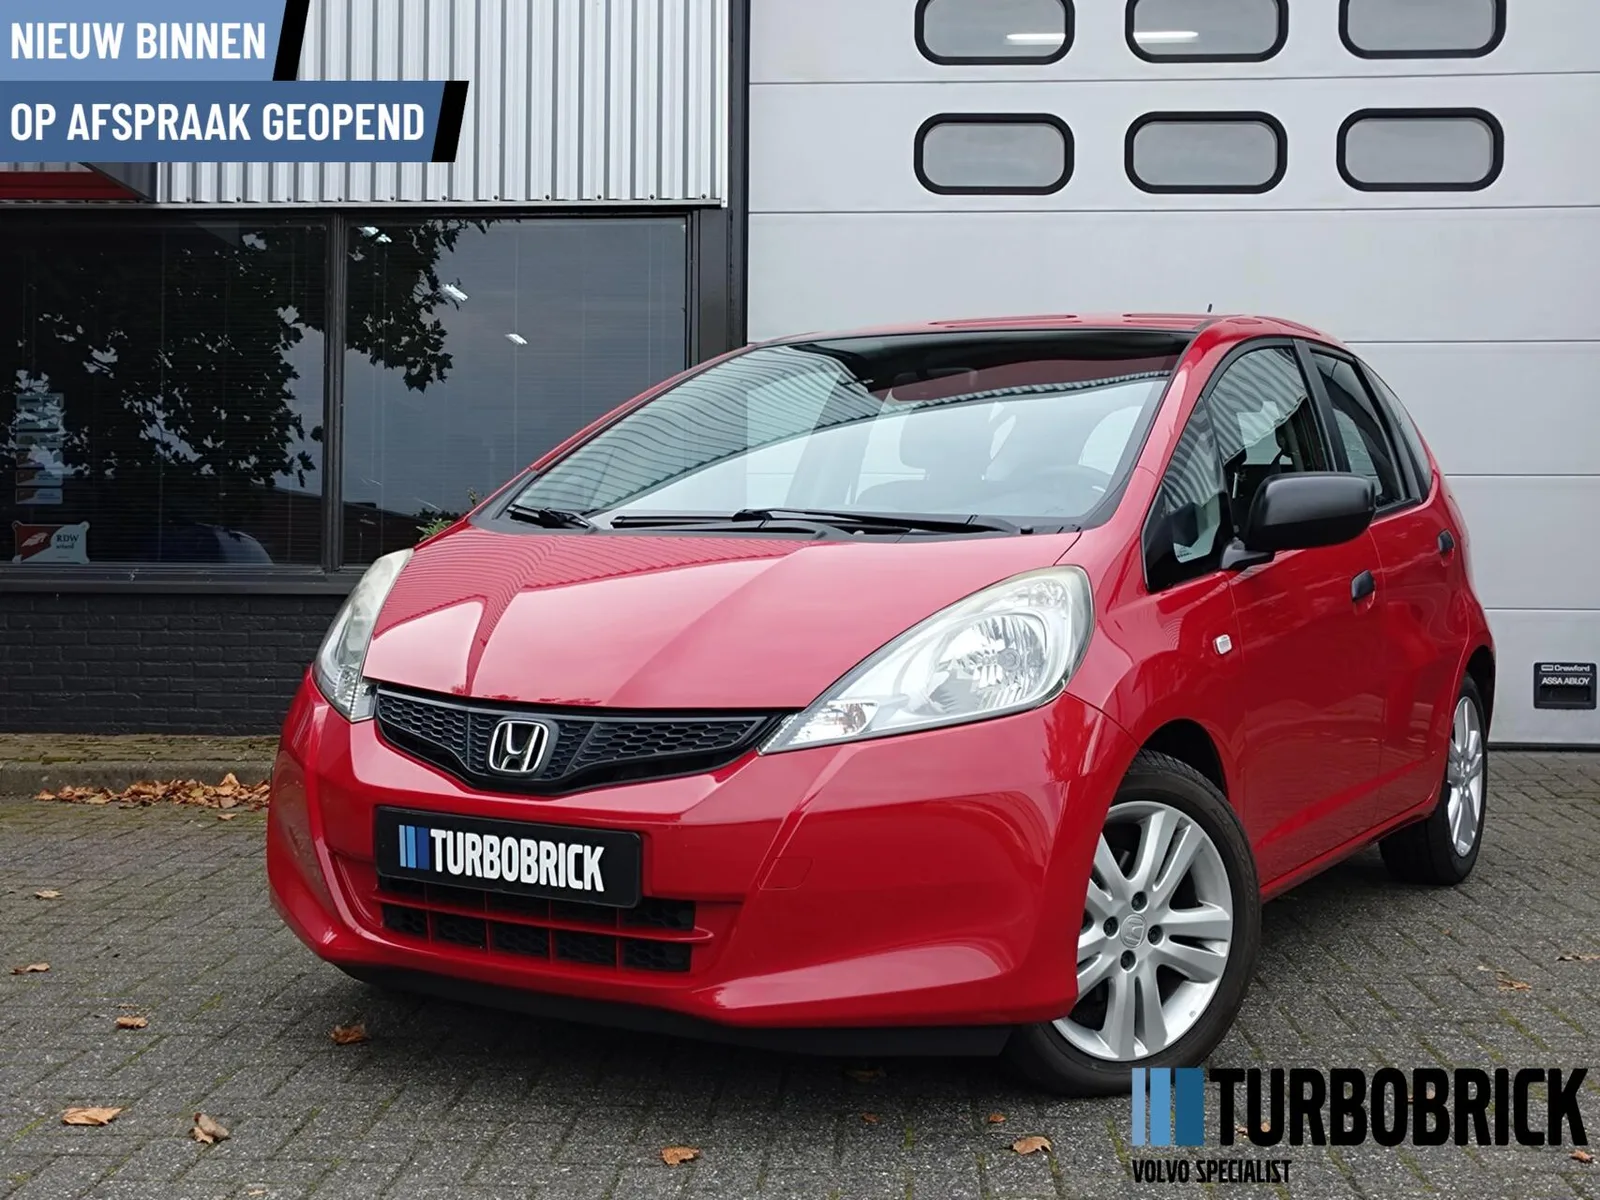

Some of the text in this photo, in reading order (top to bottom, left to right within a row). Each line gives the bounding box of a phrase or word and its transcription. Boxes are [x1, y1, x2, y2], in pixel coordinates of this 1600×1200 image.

[56, 534, 79, 542] RDW
[1554, 664, 1590, 672] Crawford
[1541, 677, 1590, 685] ASSA ABLOY
[430, 828, 605, 892] TURBOBRICK
